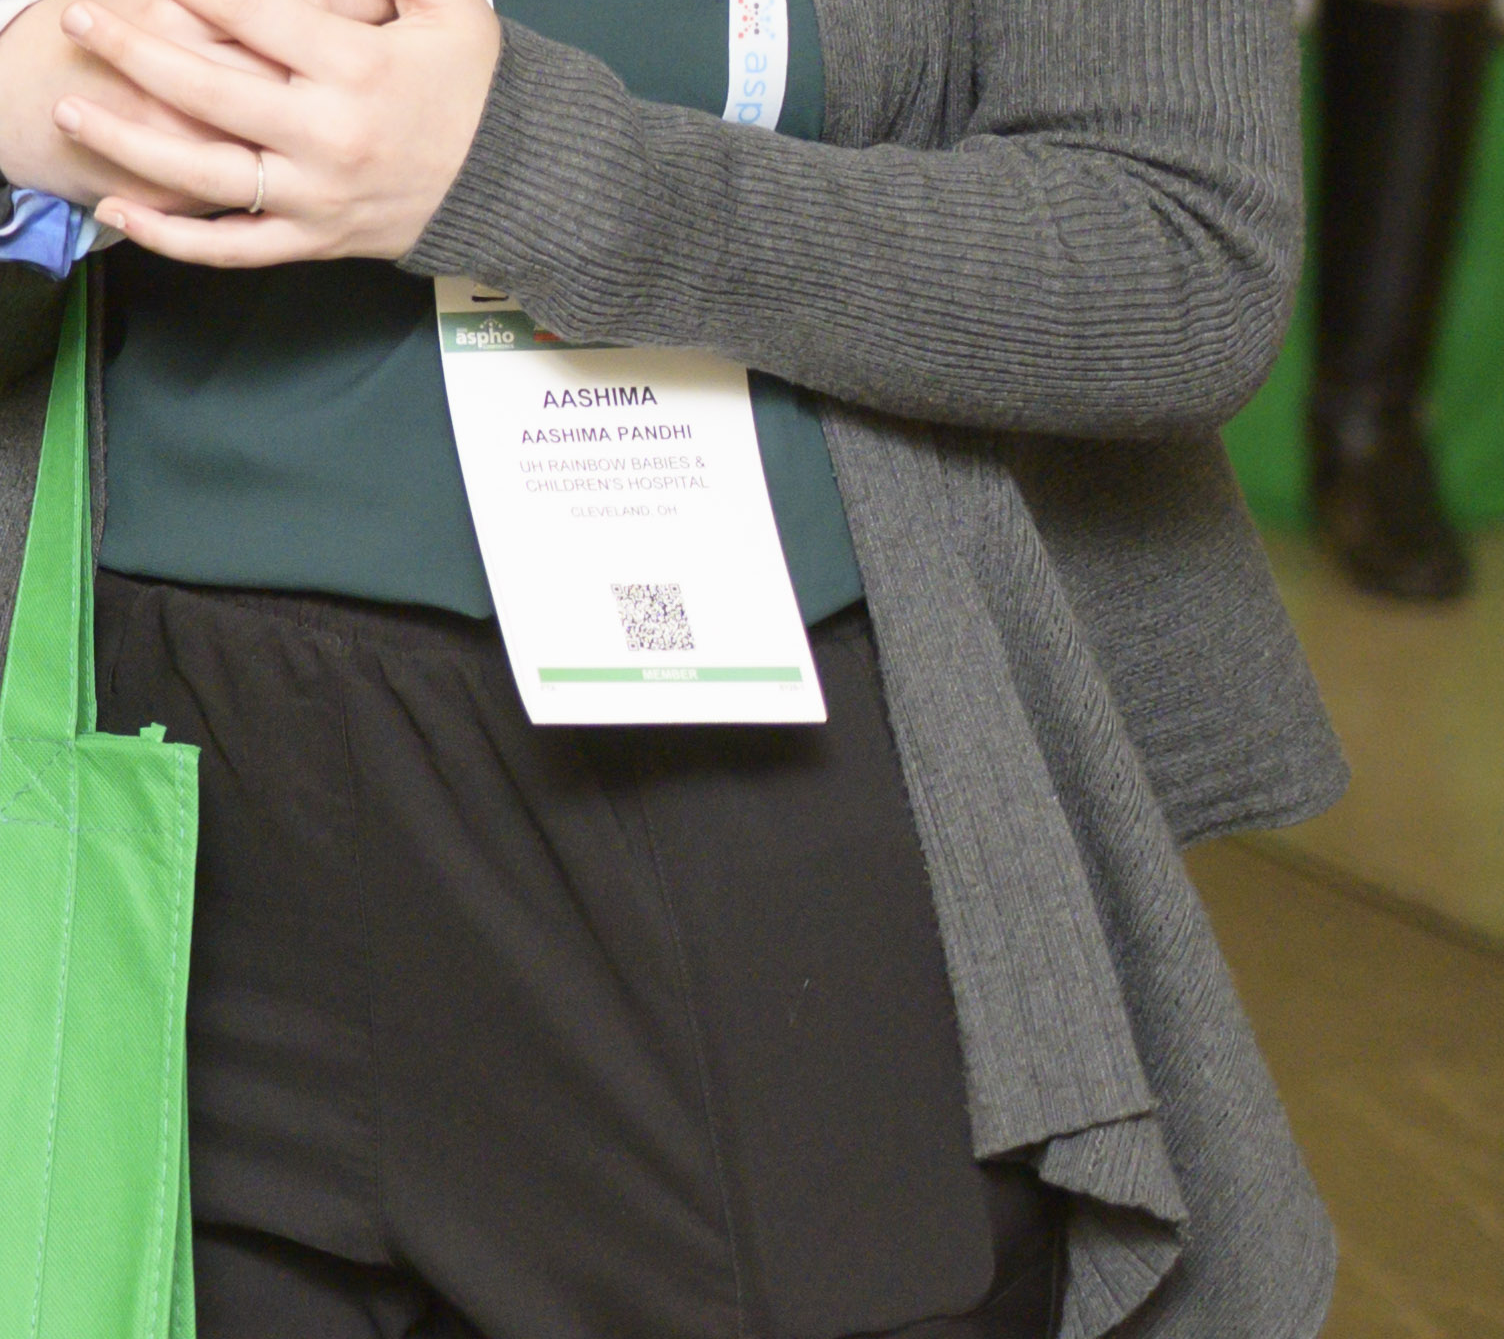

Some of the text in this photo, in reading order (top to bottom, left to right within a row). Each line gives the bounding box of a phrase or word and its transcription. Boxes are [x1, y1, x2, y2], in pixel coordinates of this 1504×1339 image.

[734, 50, 769, 124] asp
[455, 324, 515, 349] aspho
[543, 386, 658, 409] AASHIMA
[521, 424, 693, 445] AASHIMA PANDHI
[519, 455, 706, 474] UH RAINBOW BABIES &
[525, 475, 710, 493] CHILDREN'S HOSPITAL
[570, 505, 678, 519] CLEVELAND, OH
[641, 668, 699, 681] MEMBER
